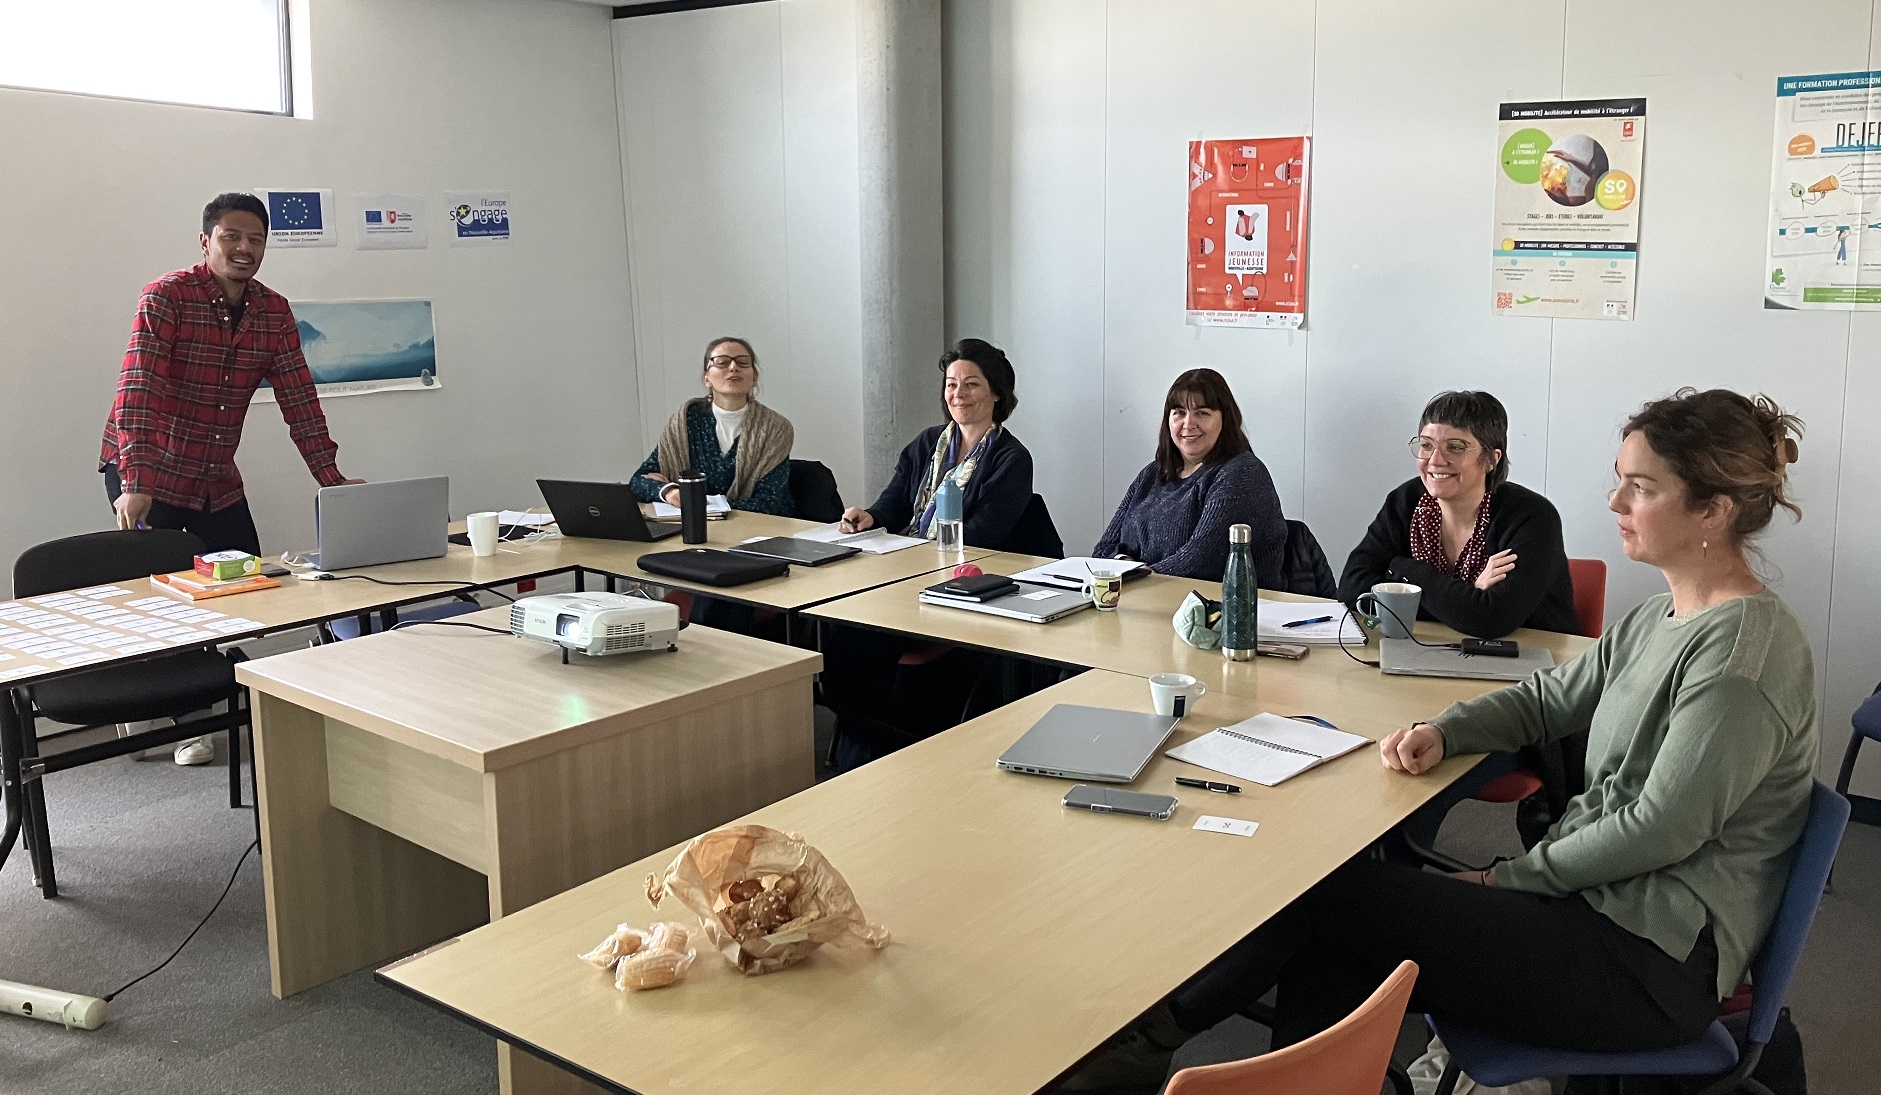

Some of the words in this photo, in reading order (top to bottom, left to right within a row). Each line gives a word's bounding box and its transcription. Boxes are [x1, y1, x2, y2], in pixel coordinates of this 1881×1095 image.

[1783, 81, 1797, 90] UNE
[1798, 79, 1838, 89] FORMATION
[480, 199, 507, 208] l'Europe
[1227, 250, 1265, 258] INFORMATION
[1227, 257, 1265, 266] JEUNESSE
